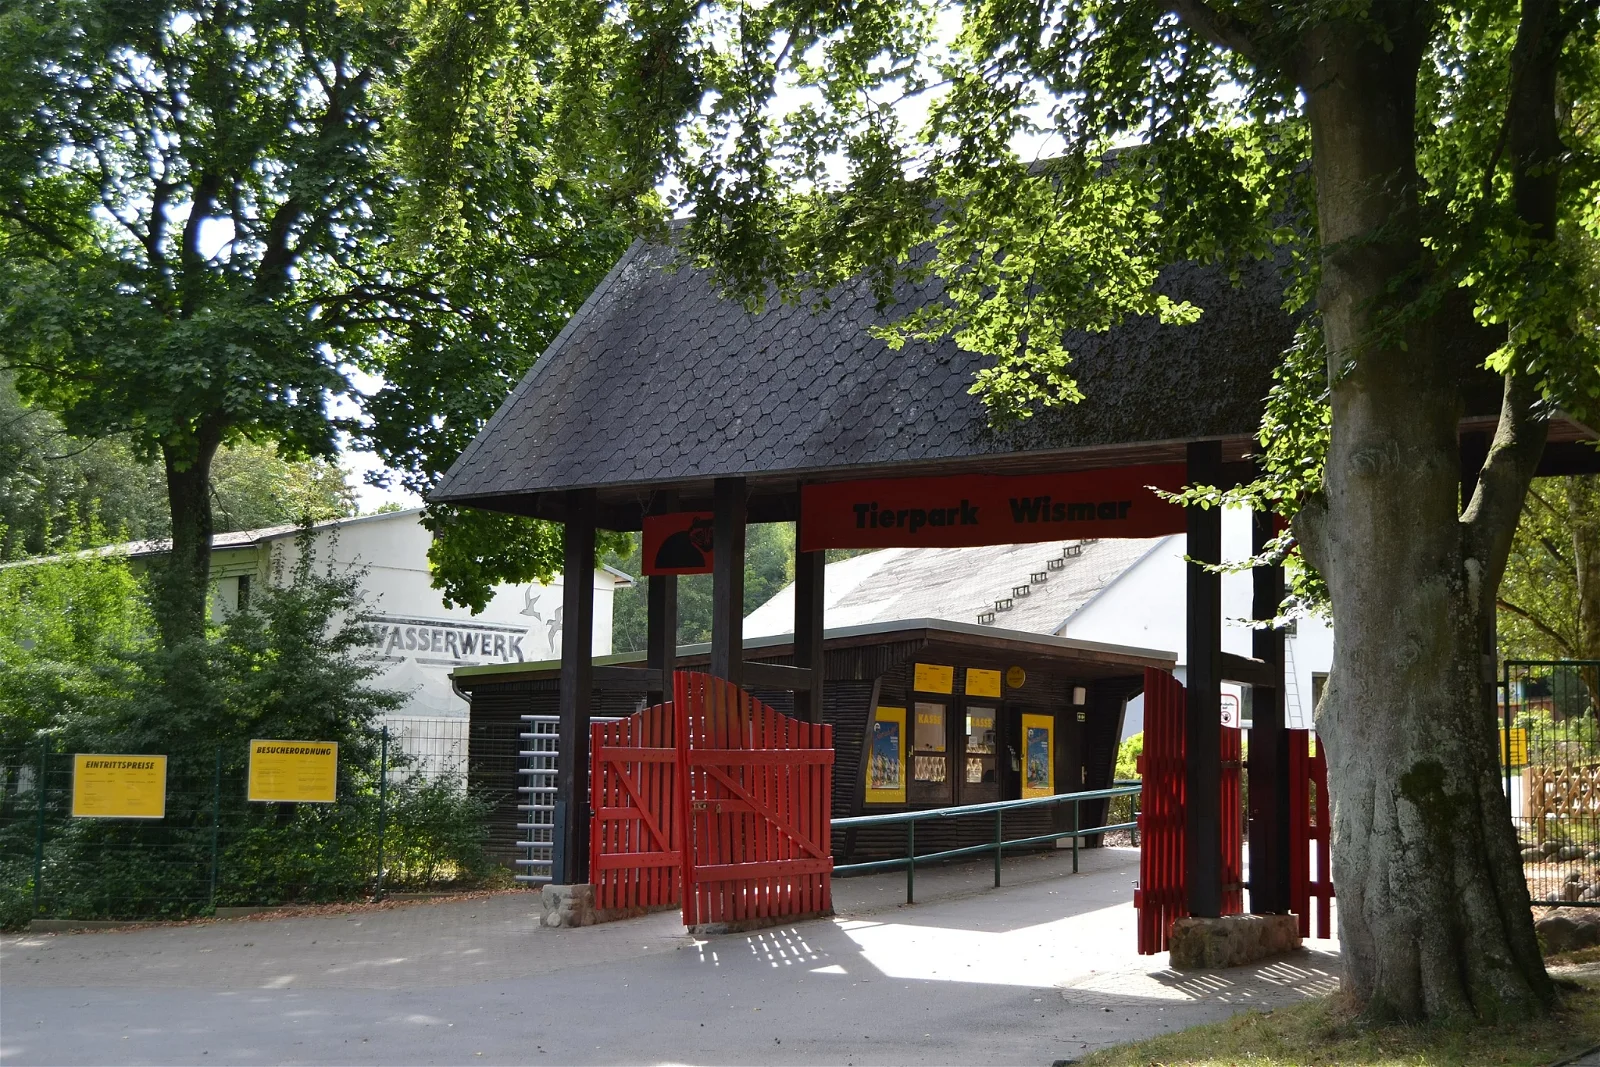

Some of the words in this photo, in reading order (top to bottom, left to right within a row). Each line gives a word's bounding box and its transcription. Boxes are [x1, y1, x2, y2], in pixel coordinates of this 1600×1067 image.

[853, 499, 979, 533] Tierpark
[1009, 495, 1132, 525] Wismar
[918, 714, 942, 725] KASSE
[256, 746, 332, 756] BESUCHERORDNUNG
[85, 760, 155, 770] EINTRITTSPREISE
